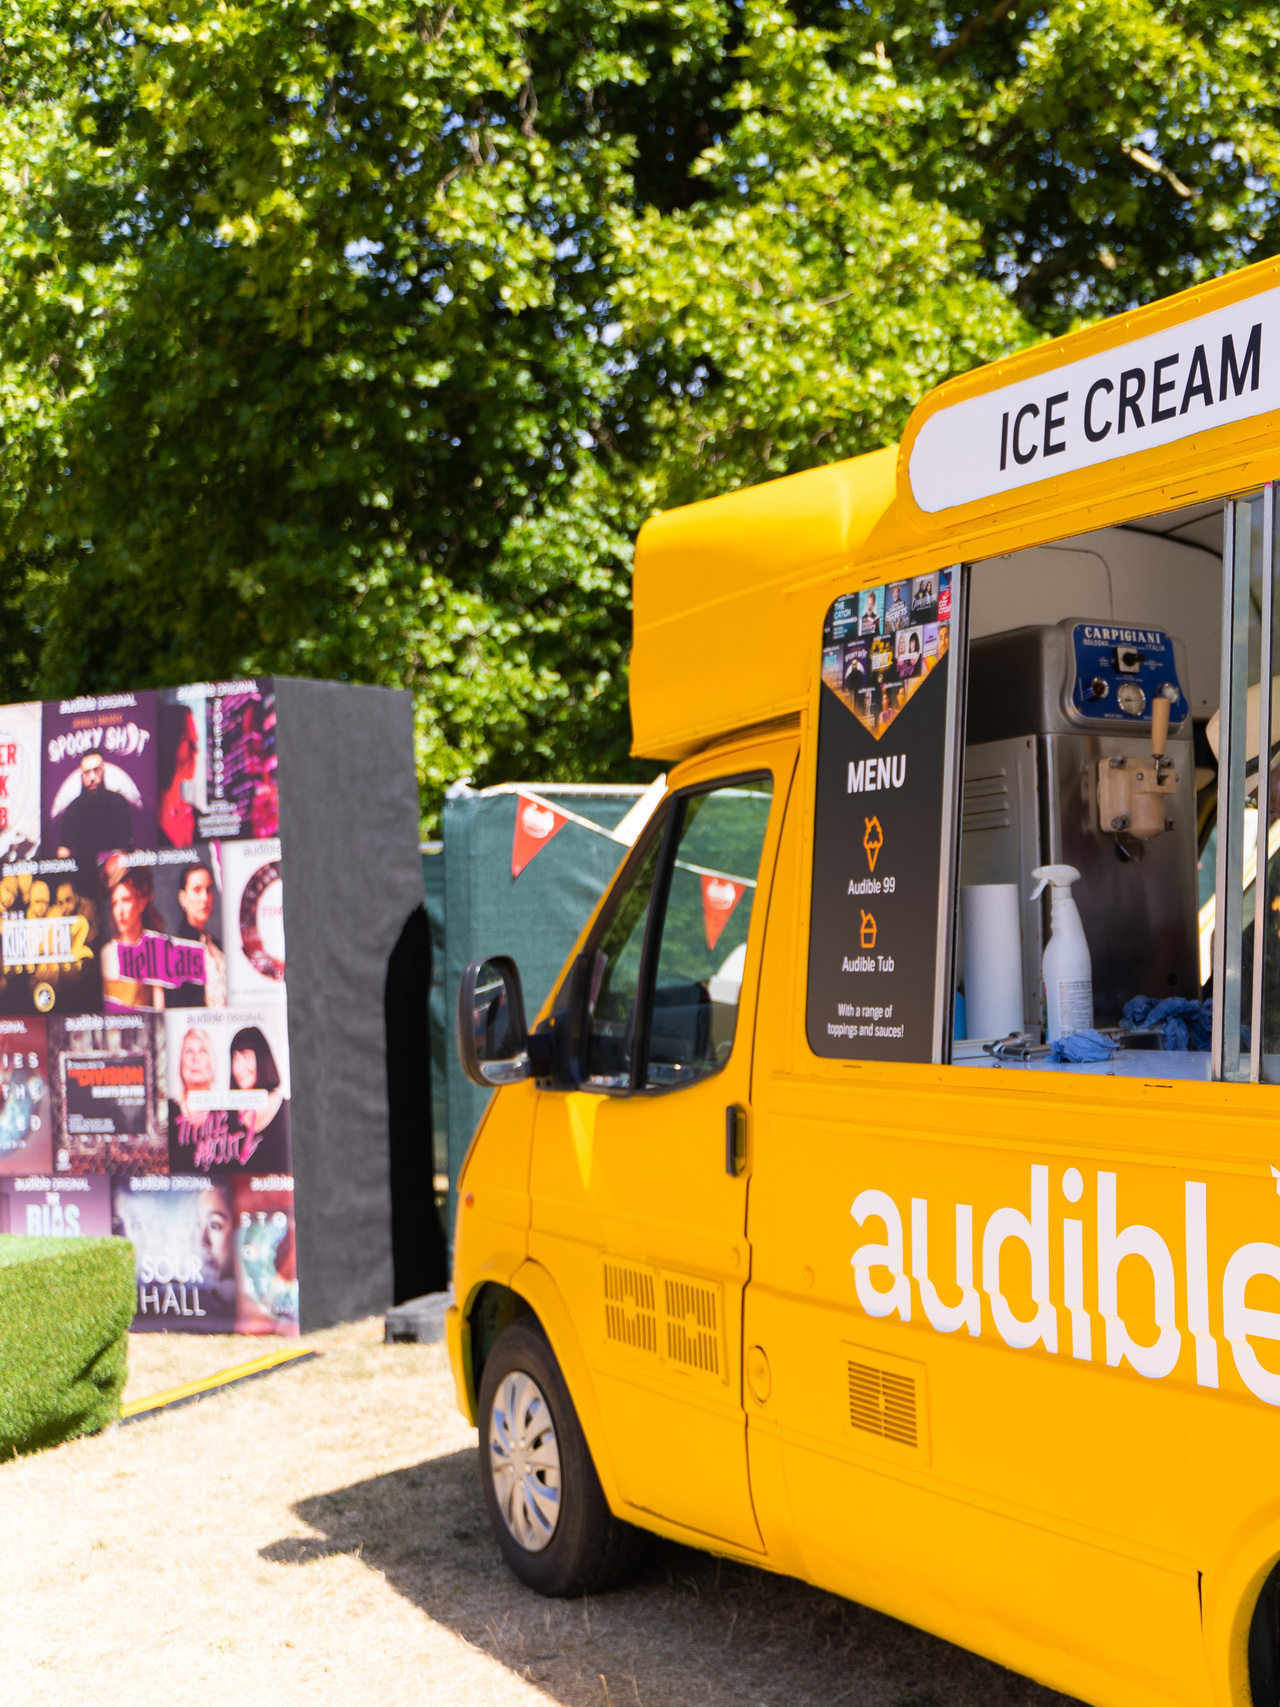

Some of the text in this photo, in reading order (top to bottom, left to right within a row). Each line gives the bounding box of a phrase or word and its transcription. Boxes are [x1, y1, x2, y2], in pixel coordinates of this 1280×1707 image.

[999, 322, 1263, 472] ICE CREAM
[1084, 626, 1161, 644] CARPIGIANI
[1083, 639, 1109, 647] BOLOGNA
[1145, 643, 1166, 652] ITALIA
[176, 680, 260, 701] audible ORIGINAL
[59, 692, 138, 715] audible ORIGINAL
[48, 726, 103, 764] SPOOKY
[847, 754, 907, 794] MENU
[118, 848, 201, 868] audible ORIGINAL
[244, 842, 282, 858] audible
[2, 857, 80, 877] audible ORIGINAL
[847, 876, 896, 895] Audible 99
[122, 938, 204, 980] Hell Cats
[842, 955, 895, 972] Audible Tub
[186, 1012, 223, 1025] audible
[838, 1003, 894, 1021] With a range of
[64, 1013, 146, 1032] audible ORIGINAL
[827, 1022, 904, 1039] toppings and sauces!
[78, 1065, 144, 1087] DIVISION
[14, 1174, 91, 1192] audible ORIGINAL
[129, 1174, 215, 1192] audible ORIGINAL
[250, 1174, 295, 1192] audible
[25, 1203, 81, 1237] BIAS
[139, 1255, 204, 1285] SOUR
[139, 1284, 207, 1317] HALL
